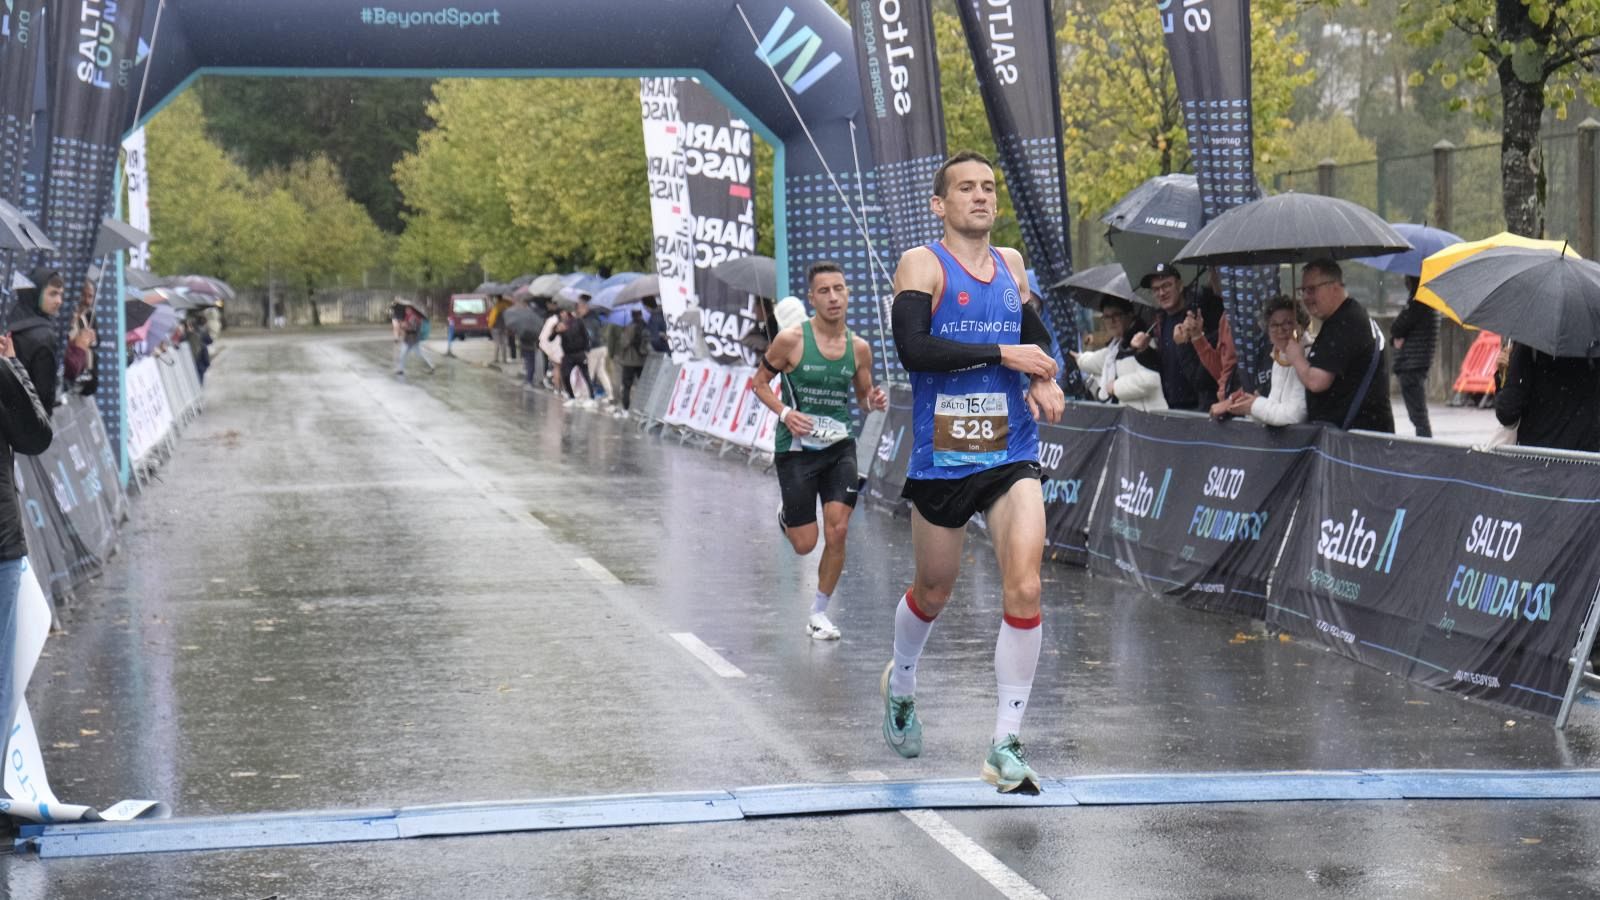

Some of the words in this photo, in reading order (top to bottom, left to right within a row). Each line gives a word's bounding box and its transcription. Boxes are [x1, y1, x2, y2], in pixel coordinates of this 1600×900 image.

[360, 8, 500, 28] #BeyondSport
[77, 0, 101, 83] SALT
[940, 320, 1002, 335] ATLETISMO
[940, 401, 965, 410] SALTO
[951, 419, 994, 440] 528
[1203, 466, 1245, 500] SALTO
[1317, 508, 1377, 569] salto
[1465, 514, 1522, 562] SALTO
